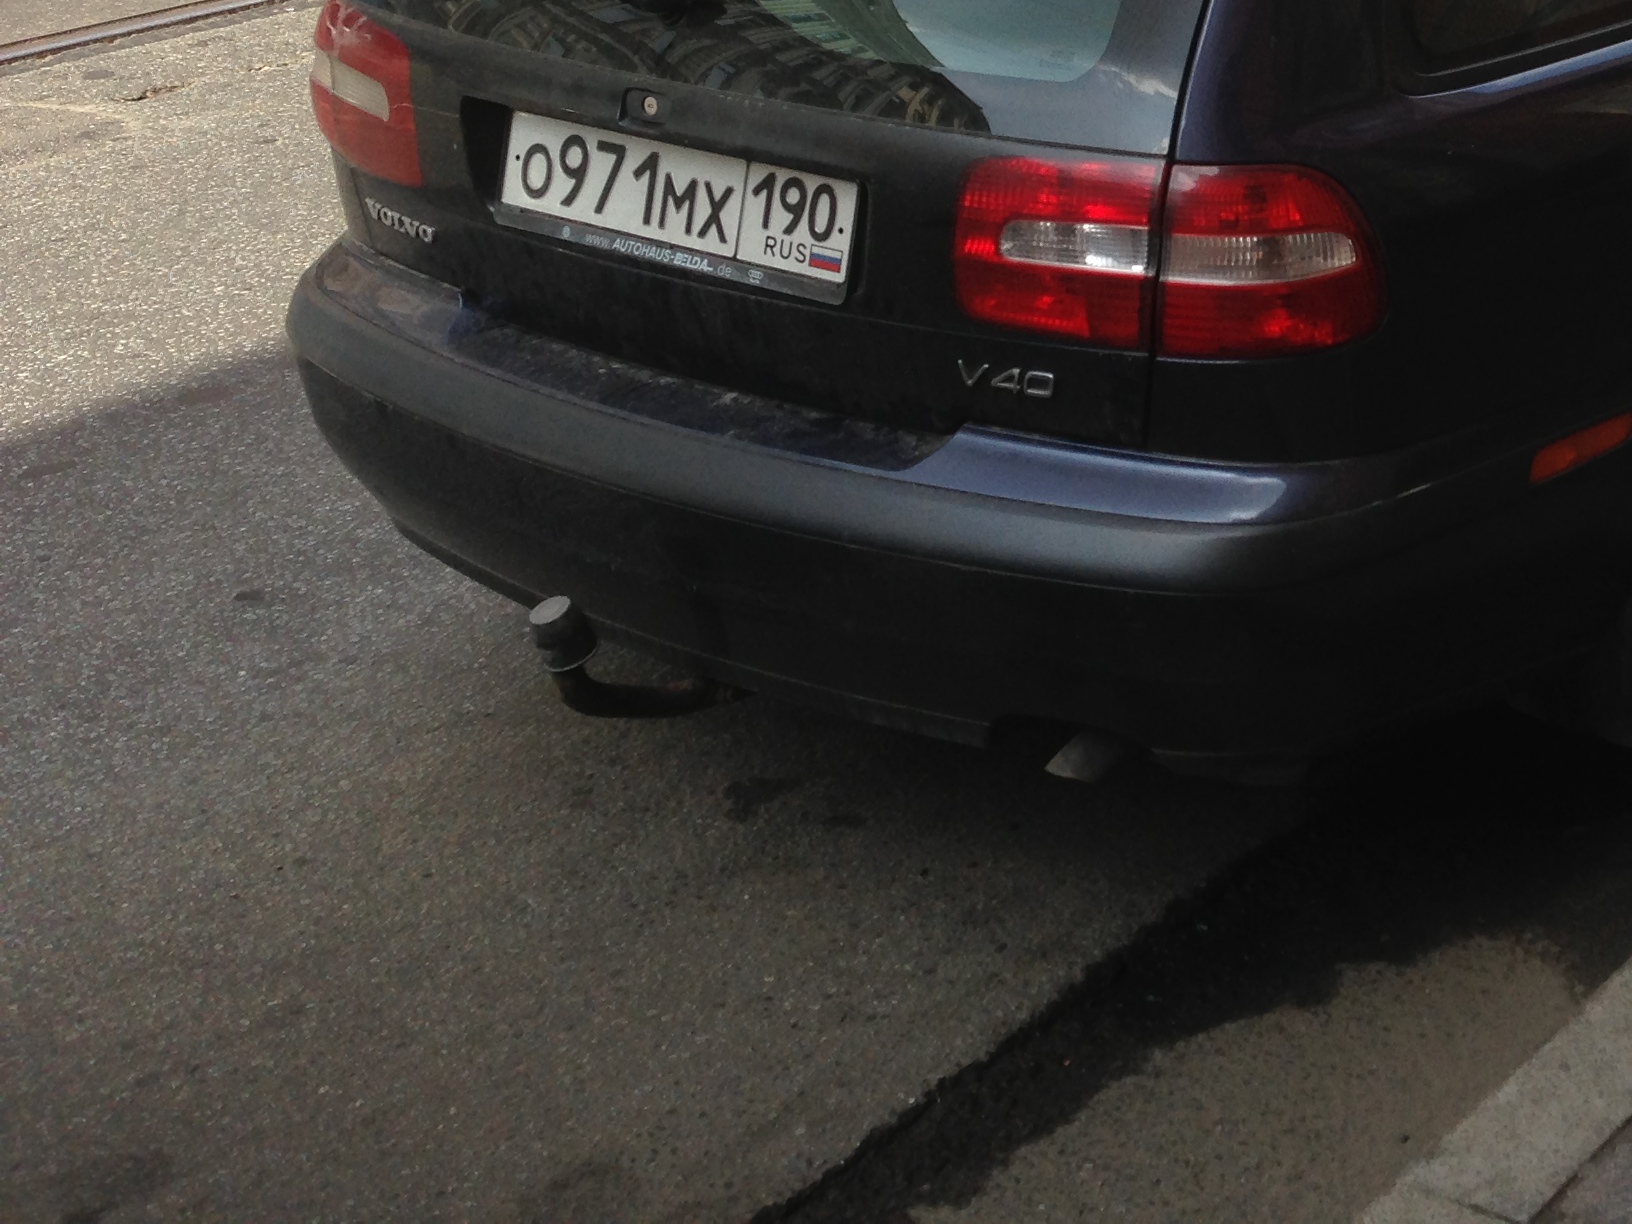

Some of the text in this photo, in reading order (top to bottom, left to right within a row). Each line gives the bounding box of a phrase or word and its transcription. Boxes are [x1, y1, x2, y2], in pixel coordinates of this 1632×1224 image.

[365, 196, 436, 243] VOLVO
[752, 171, 838, 243] 190
[763, 235, 808, 264] RUS
[957, 359, 1054, 398] V40
